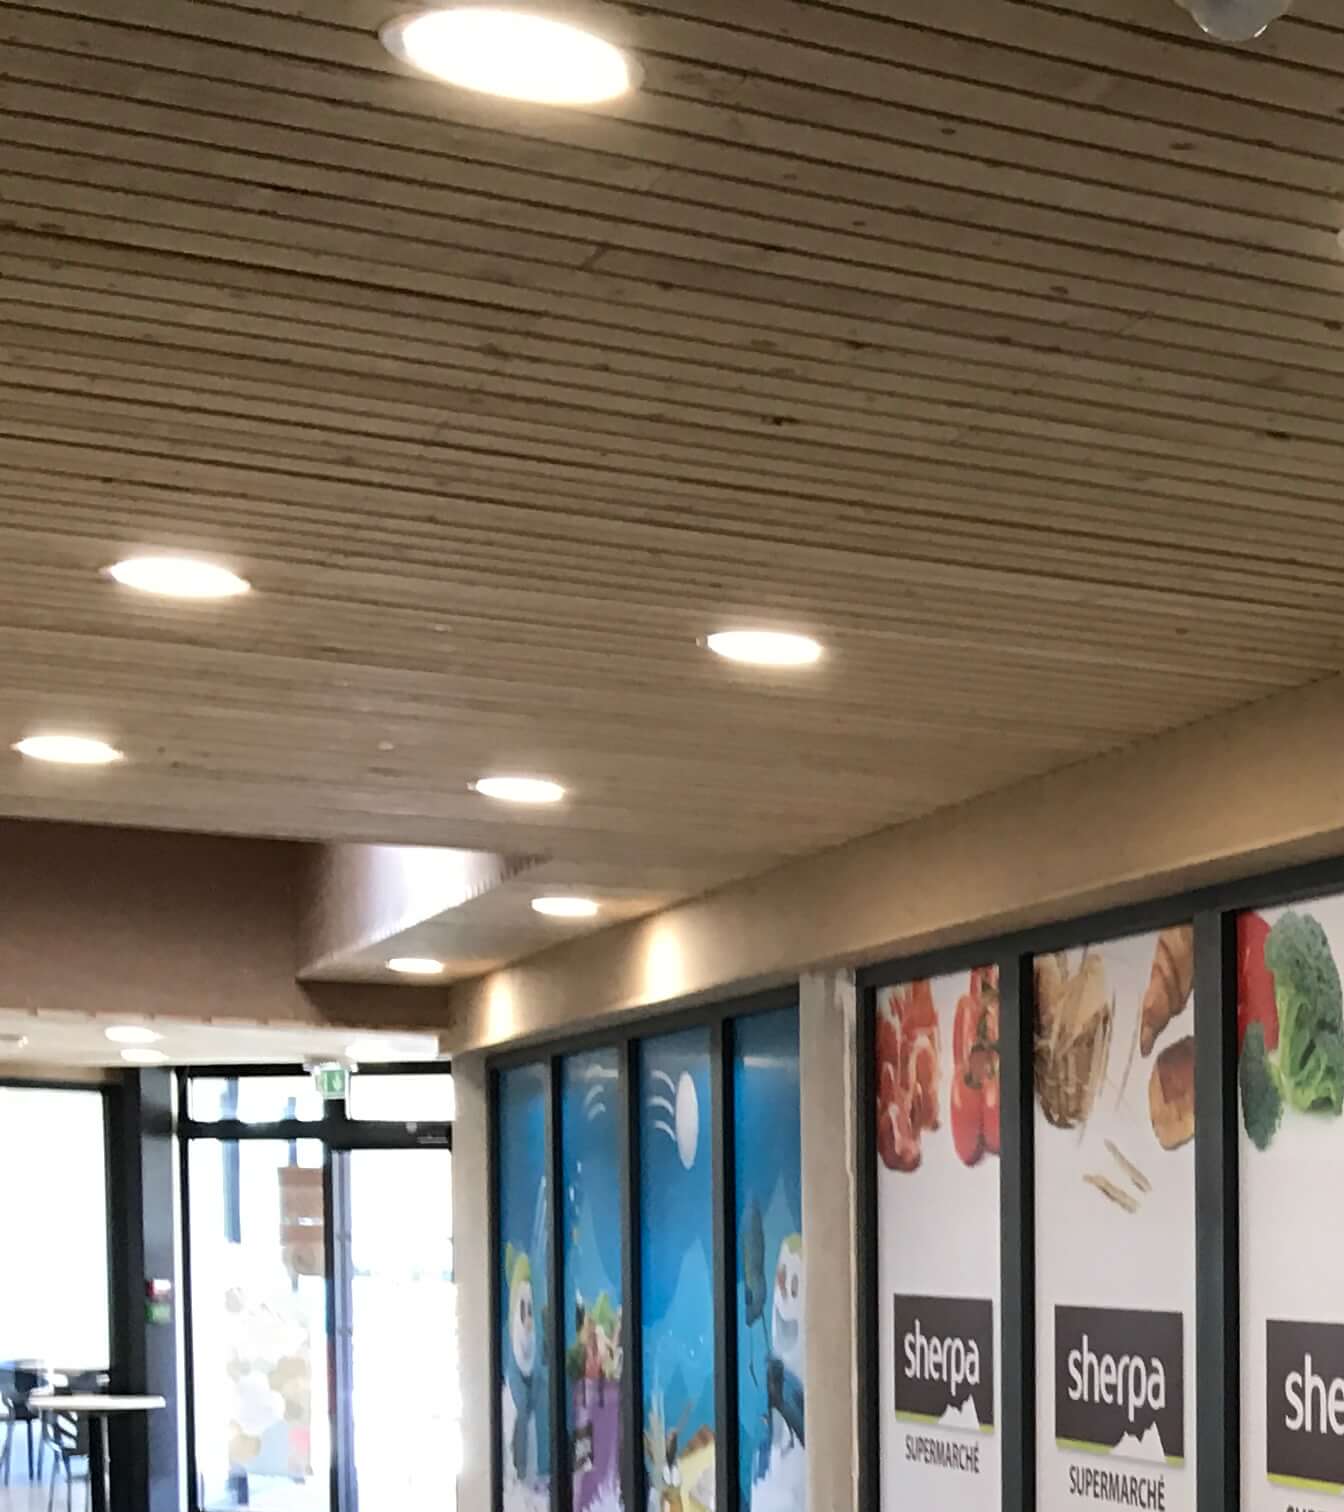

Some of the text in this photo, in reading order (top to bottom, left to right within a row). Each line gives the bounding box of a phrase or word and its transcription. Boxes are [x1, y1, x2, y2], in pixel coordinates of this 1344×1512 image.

[903, 1319, 980, 1396] sherpa
[1067, 1334, 1166, 1422] sherpa
[905, 1434, 980, 1474] SUPERMARCHÉ
[1069, 1466, 1166, 1512] SUPERMARCHÉ
